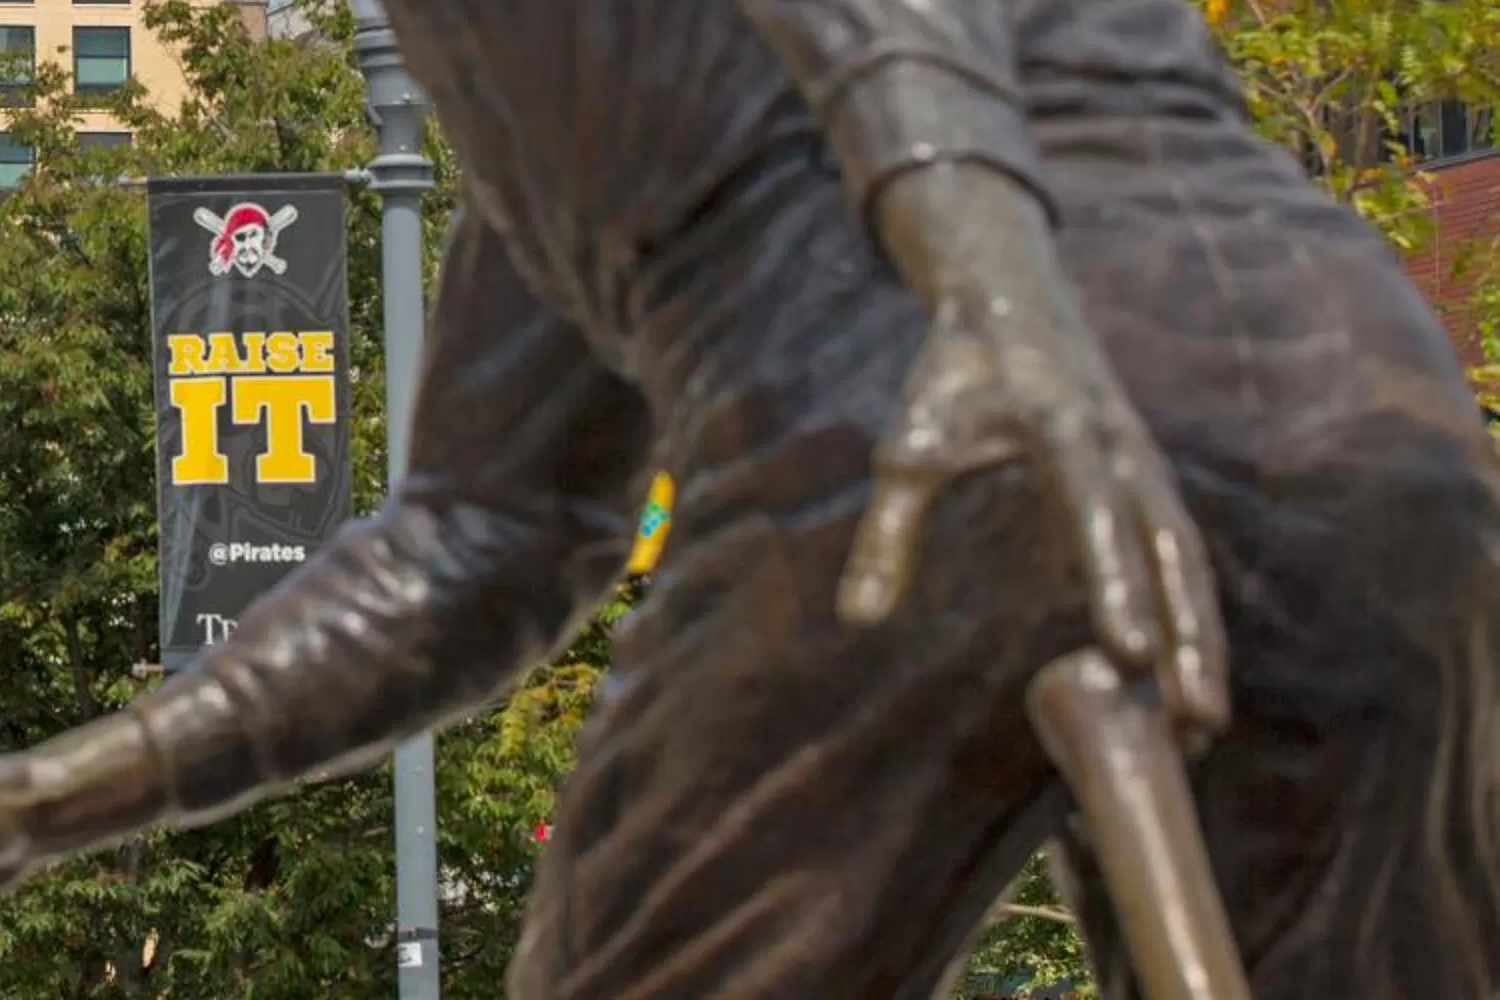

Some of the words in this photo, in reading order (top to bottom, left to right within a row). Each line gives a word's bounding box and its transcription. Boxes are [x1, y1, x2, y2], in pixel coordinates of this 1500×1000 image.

[167, 331, 335, 376] RAISE
[169, 376, 336, 485] IT
[208, 541, 306, 566] @Pirates
